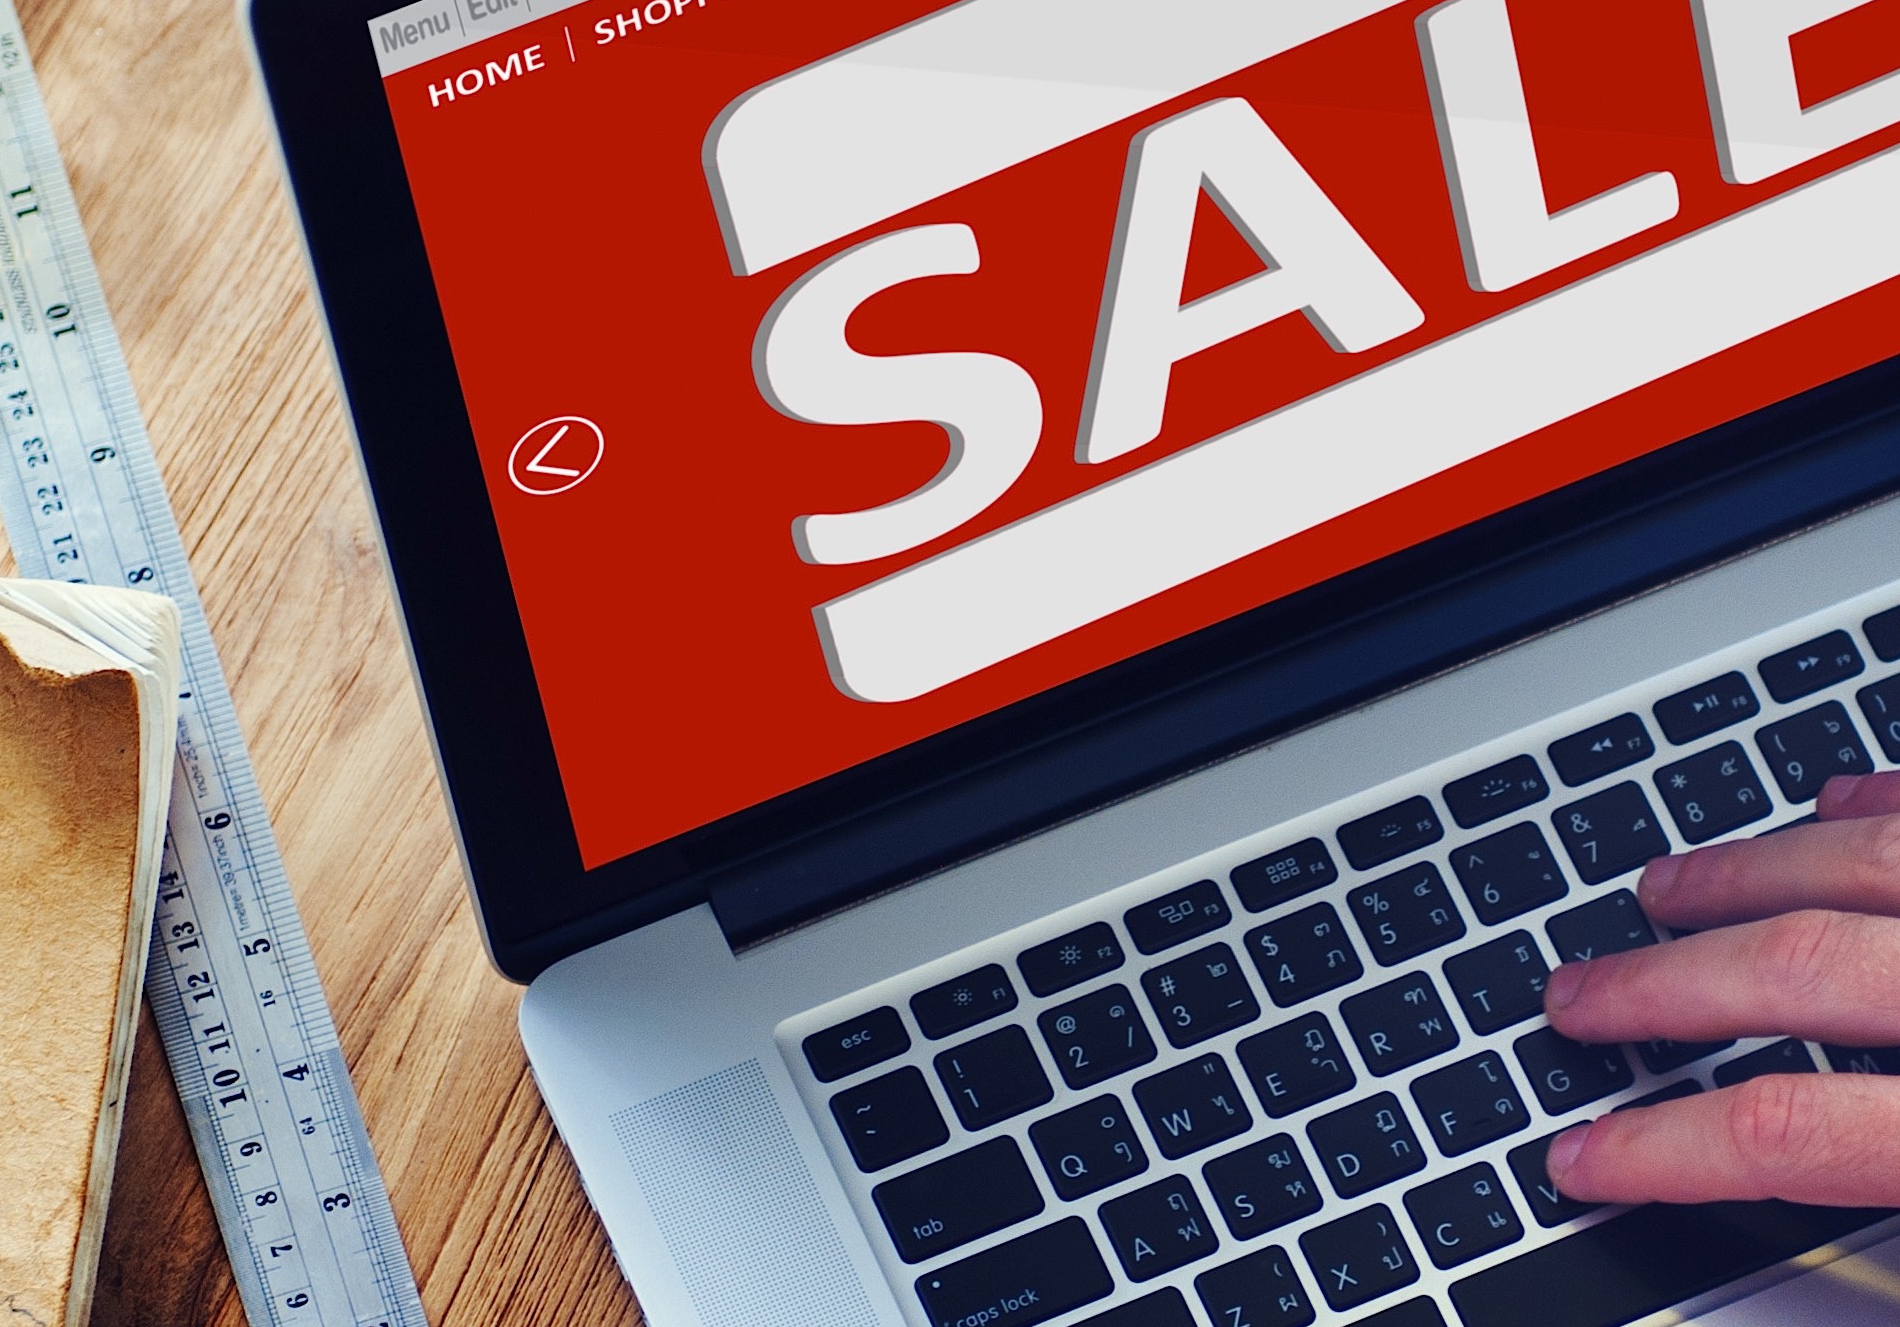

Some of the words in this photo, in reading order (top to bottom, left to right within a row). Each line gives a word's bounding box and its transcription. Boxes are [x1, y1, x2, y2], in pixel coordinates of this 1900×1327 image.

[377, 8, 452, 54] Menu
[426, 43, 546, 109] HOME
[7, 183, 40, 218] 11
[46, 304, 77, 338] 10
[7, 388, 34, 419] 24
[21, 435, 50, 467] 23
[89, 445, 116, 464] 9
[36, 483, 65, 514] 22
[52, 533, 79, 565] 21
[127, 566, 154, 584] 8
[1626, 736, 1641, 750] F7
[1787, 761, 1804, 782] 9
[204, 812, 231, 831] 6
[1685, 801, 1705, 823] 8
[1416, 819, 1432, 832] F5
[1582, 840, 1597, 863] 7
[1309, 861, 1325, 874] F4
[1483, 883, 1500, 904] 6
[1203, 903, 1220, 916] F3
[171, 921, 199, 954] 13
[1379, 922, 1397, 945] 5
[243, 938, 271, 957] 5
[1096, 946, 1113, 959] F2
[1279, 963, 1295, 983] 4
[186, 971, 214, 1004] 12
[260, 989, 276, 1008] 16
[992, 987, 1006, 1000] F1
[1472, 989, 1491, 1012] T
[1172, 1005, 1191, 1027] 3
[203, 1021, 231, 1053] 11
[841, 1029, 871, 1049] esc
[1369, 1032, 1393, 1056] R
[1068, 1045, 1089, 1068] 2
[282, 1063, 310, 1083] 4
[1265, 1072, 1287, 1097] E
[1546, 1069, 1571, 1092] G
[212, 1069, 246, 1107] 10
[963, 1088, 979, 1108] 1
[1161, 1108, 1192, 1137] W
[1440, 1111, 1457, 1136] F
[239, 1141, 263, 1157] 9
[1060, 1154, 1088, 1178] Q
[1336, 1153, 1360, 1178] D
[255, 1190, 278, 1207] 8
[323, 1192, 352, 1212] 3
[1234, 1194, 1255, 1218] S
[913, 1218, 944, 1240] tab
[1436, 1223, 1460, 1246] C
[271, 1242, 293, 1259] 7
[1134, 1237, 1156, 1262] A
[1330, 1263, 1358, 1291] X
[285, 1292, 310, 1309] 6
[1000, 1288, 1040, 1313] lock
